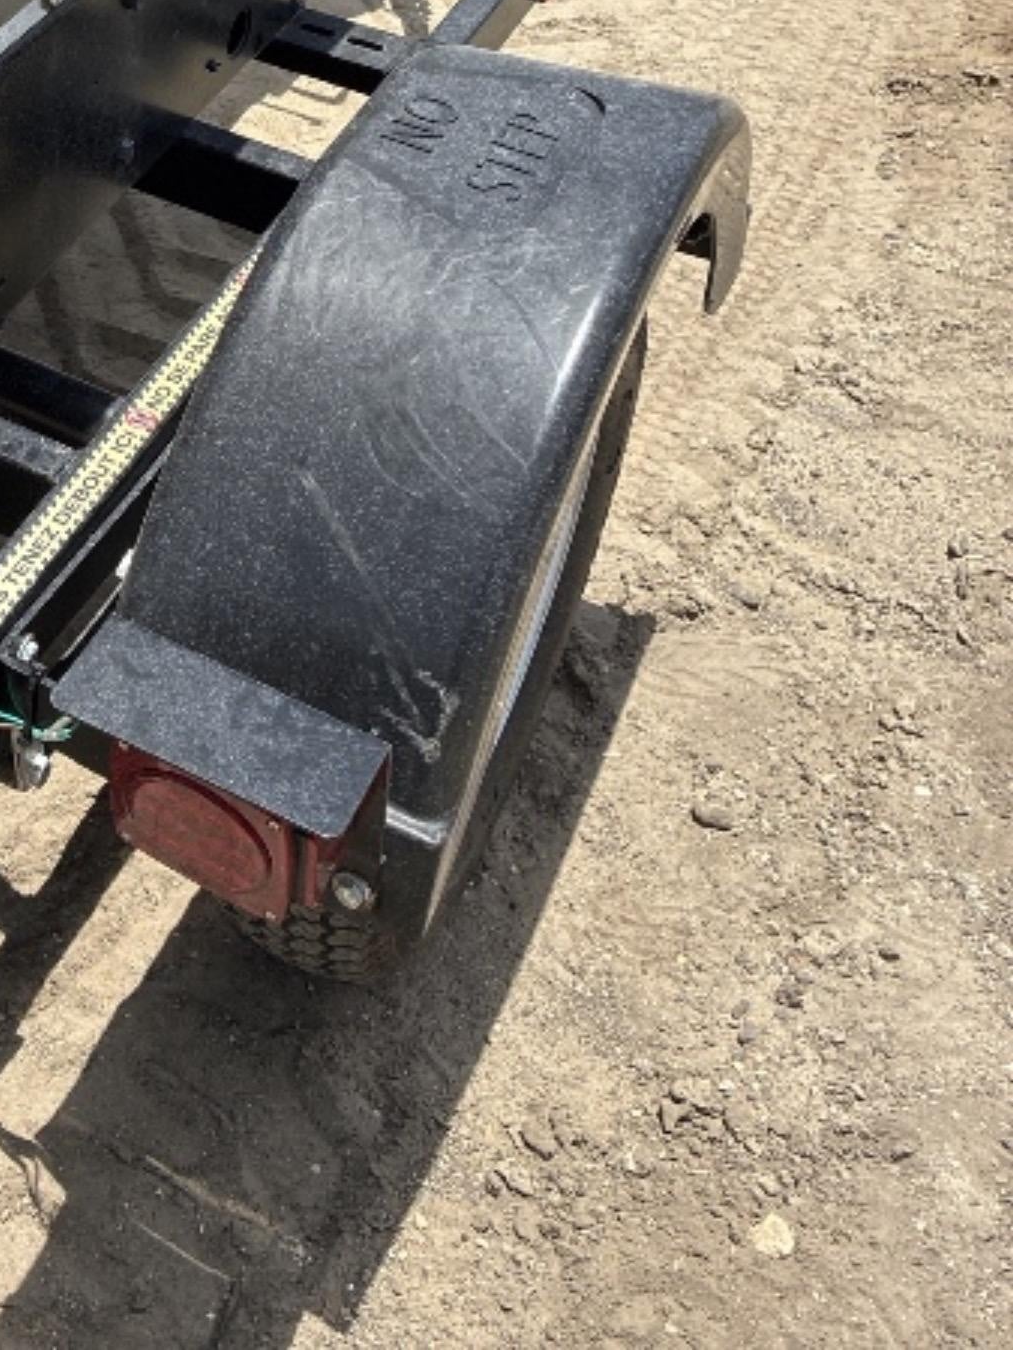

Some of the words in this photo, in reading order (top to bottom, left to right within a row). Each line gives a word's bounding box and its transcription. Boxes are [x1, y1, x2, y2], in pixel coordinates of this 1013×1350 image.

[380, 96, 460, 154] NO
[2, 528, 58, 586] TENEZ
[52, 453, 119, 528] DEBOUT
